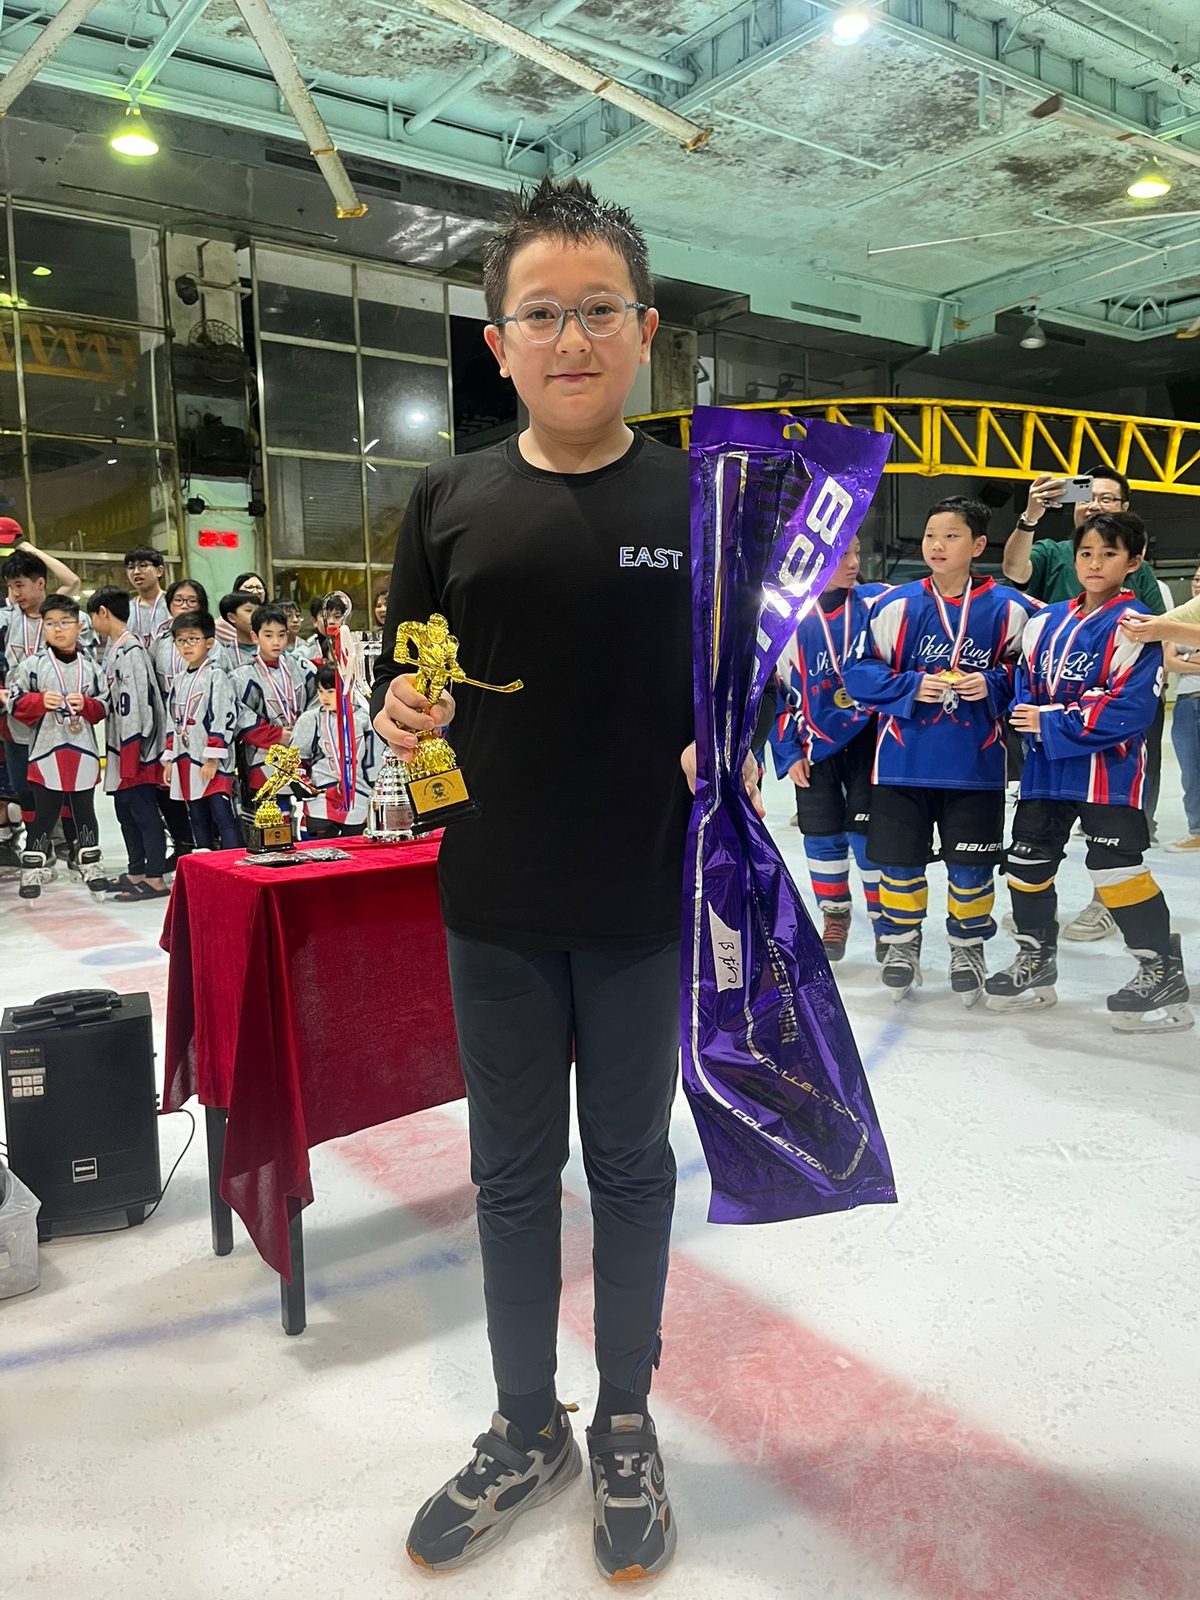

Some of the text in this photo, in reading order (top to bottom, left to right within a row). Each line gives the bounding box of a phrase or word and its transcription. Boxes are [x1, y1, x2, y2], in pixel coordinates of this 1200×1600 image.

[619, 546, 683, 570] EAST
[911, 635, 951, 663] Sky
[225, 711, 236, 731] 2
[731, 1108, 834, 1176] COLLECTION
